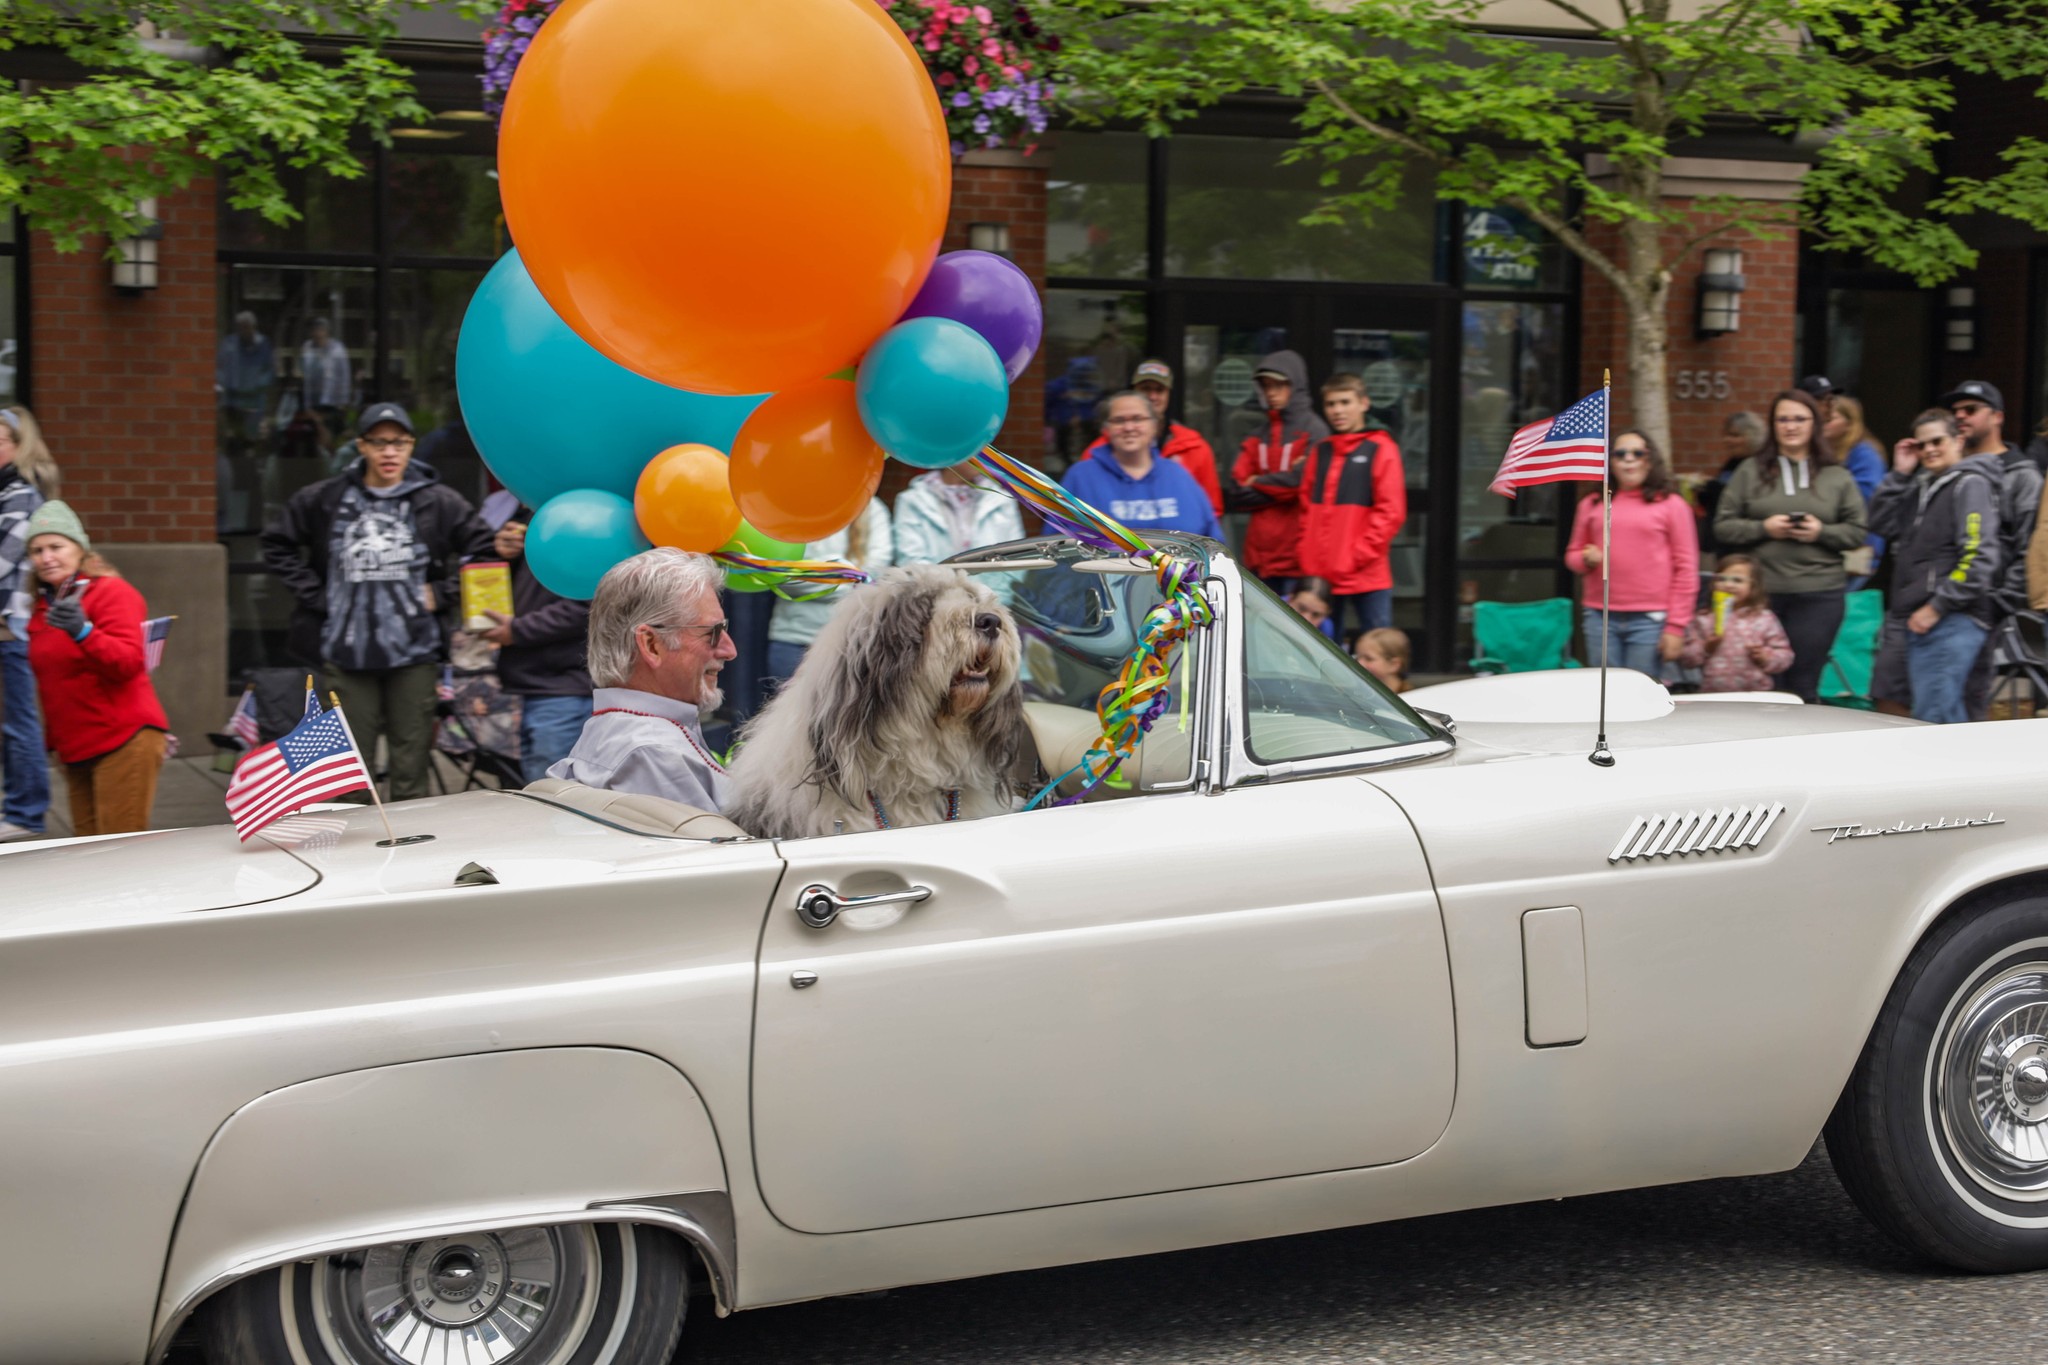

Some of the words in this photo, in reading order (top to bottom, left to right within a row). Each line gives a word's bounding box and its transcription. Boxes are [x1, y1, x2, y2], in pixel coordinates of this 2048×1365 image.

[1490, 263, 1535, 280] ATM
[1675, 370, 1732, 400] 555
[1810, 811, 2006, 845] Thunderbird
[2005, 1063, 2030, 1117] FORD
